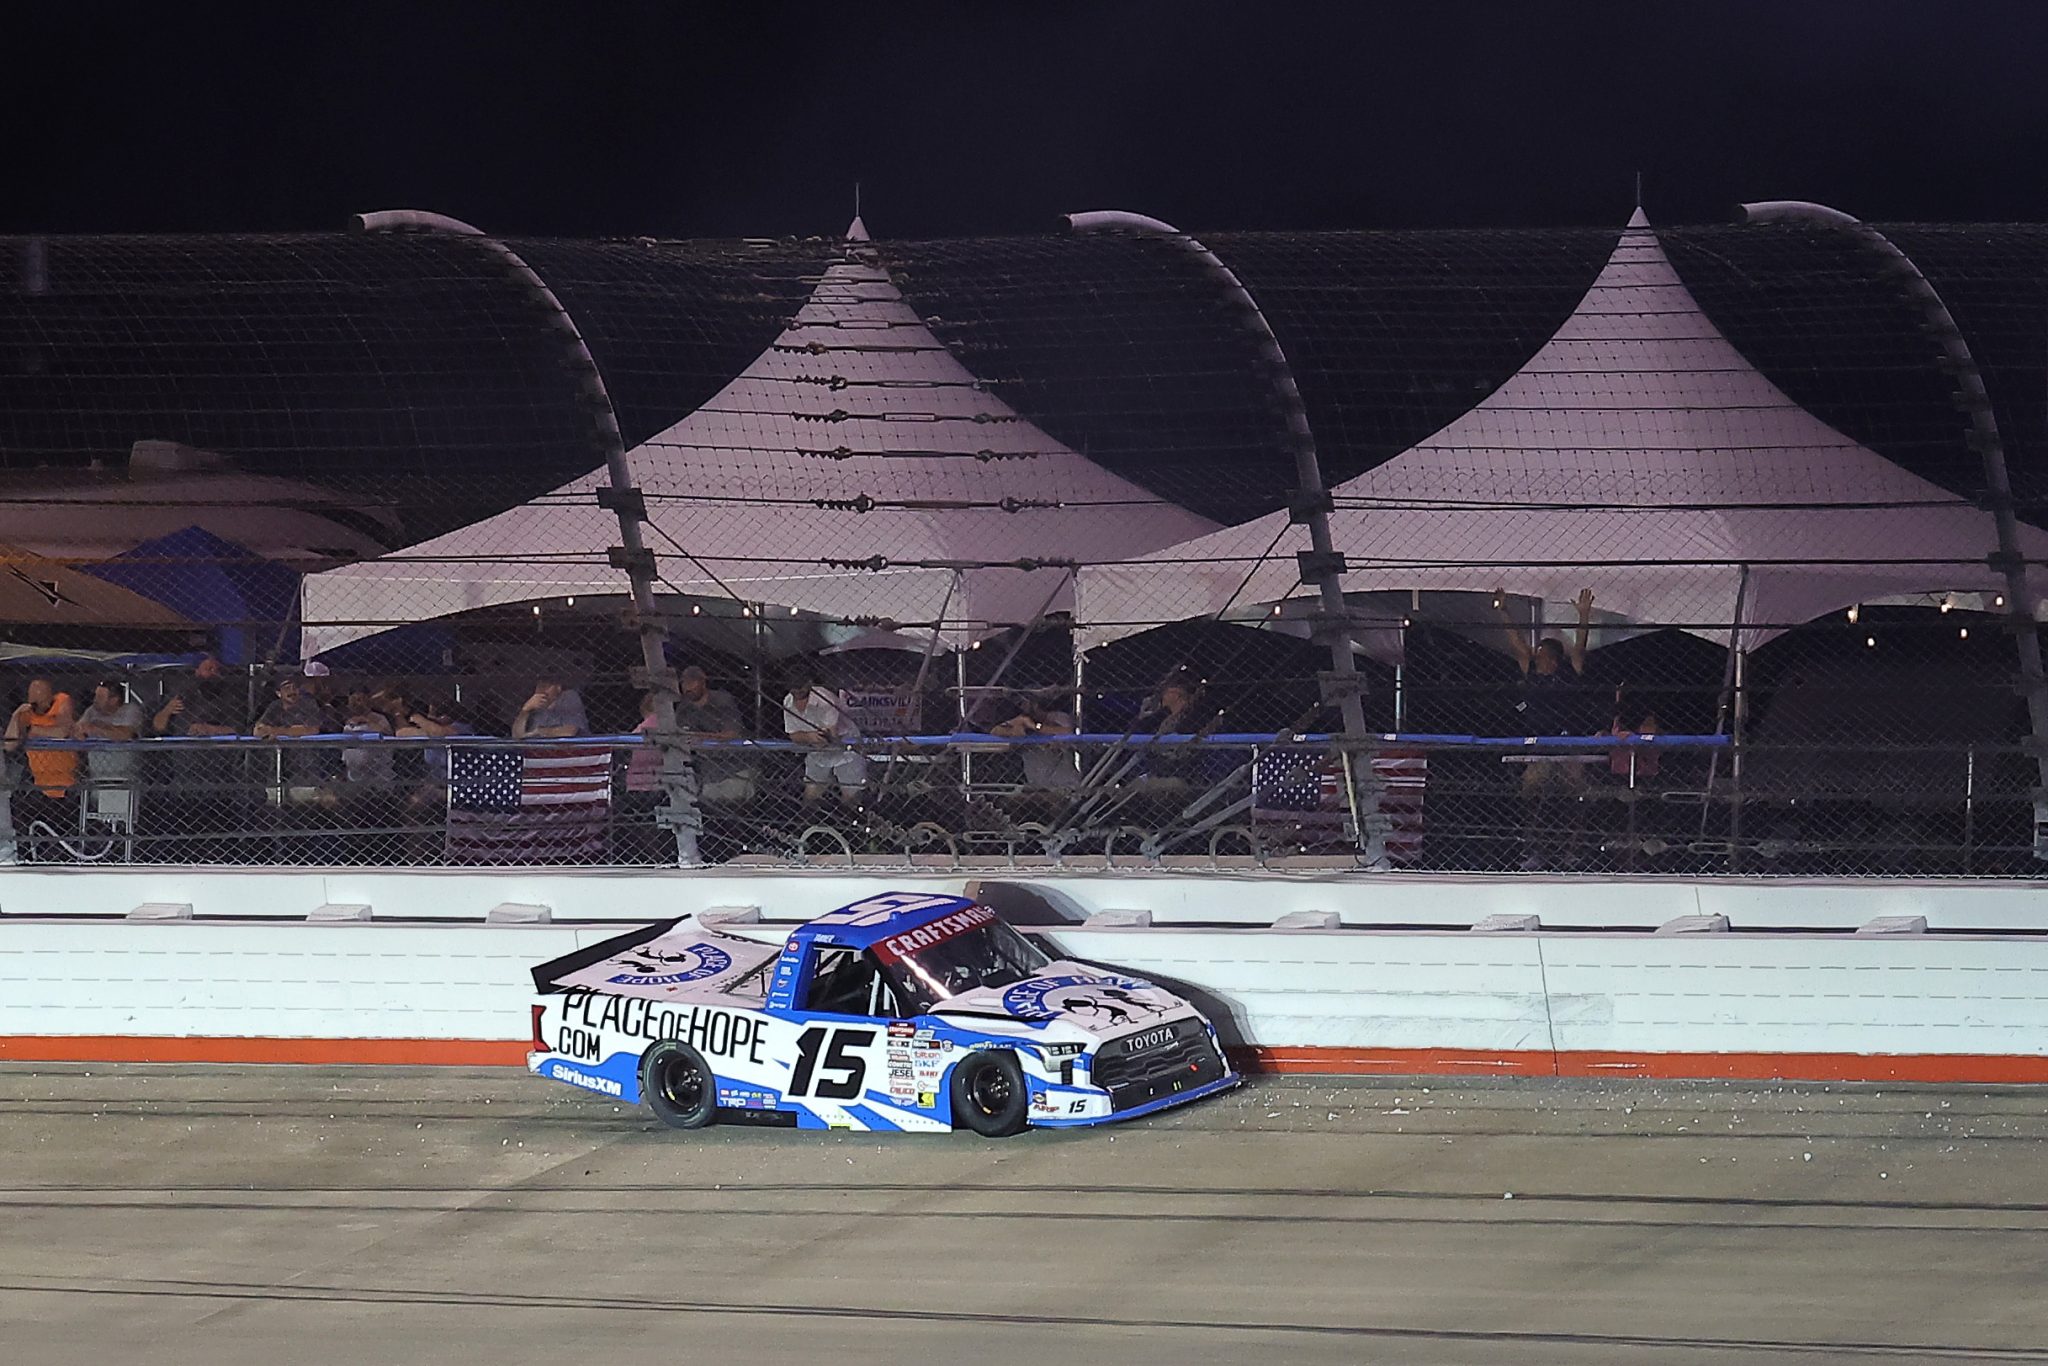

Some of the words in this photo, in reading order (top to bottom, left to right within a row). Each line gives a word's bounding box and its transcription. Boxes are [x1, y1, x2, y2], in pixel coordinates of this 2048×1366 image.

[886, 907, 991, 956] CRAFTSMAN
[550, 1026, 601, 1063] .COM
[1126, 1028, 1174, 1052] TOYOTA
[788, 1027, 877, 1100] 15
[889, 1069, 915, 1078] JESEL
[552, 1064, 622, 1096] SiriusXM
[1069, 1099, 1087, 1114] 15
